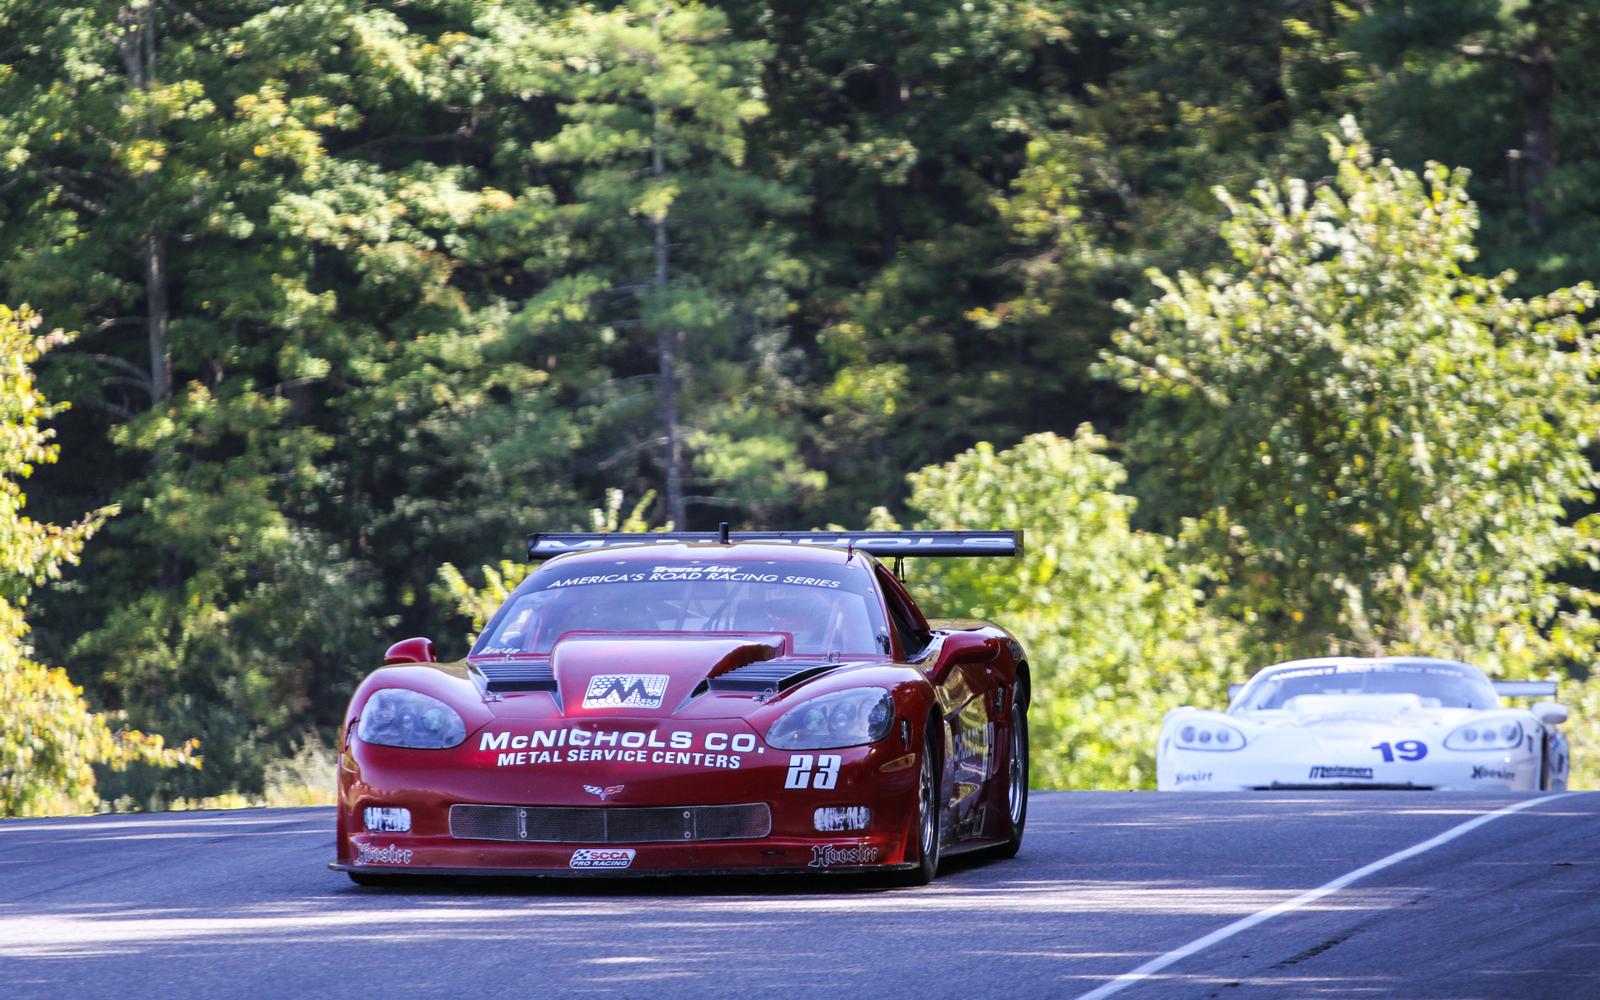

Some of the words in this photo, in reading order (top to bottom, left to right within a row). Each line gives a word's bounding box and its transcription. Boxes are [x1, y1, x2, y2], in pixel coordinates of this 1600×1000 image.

[547, 572, 645, 589] AMERICA'S
[649, 572, 701, 582] ROAD
[706, 572, 779, 583] RACING
[783, 575, 841, 589] SERIES
[652, 565, 701, 574] Trans
[702, 565, 739, 574] Am
[479, 728, 693, 751] McNICHOLS
[704, 732, 765, 754] CO.
[1371, 740, 1428, 762] 19
[497, 750, 562, 767] METAL
[566, 749, 647, 762] SERVICE
[652, 750, 741, 770] CENTERS
[784, 754, 842, 790] 23
[354, 842, 413, 865] Hoosier
[590, 851, 630, 860] SCCA
[808, 843, 879, 867] Hoosier
